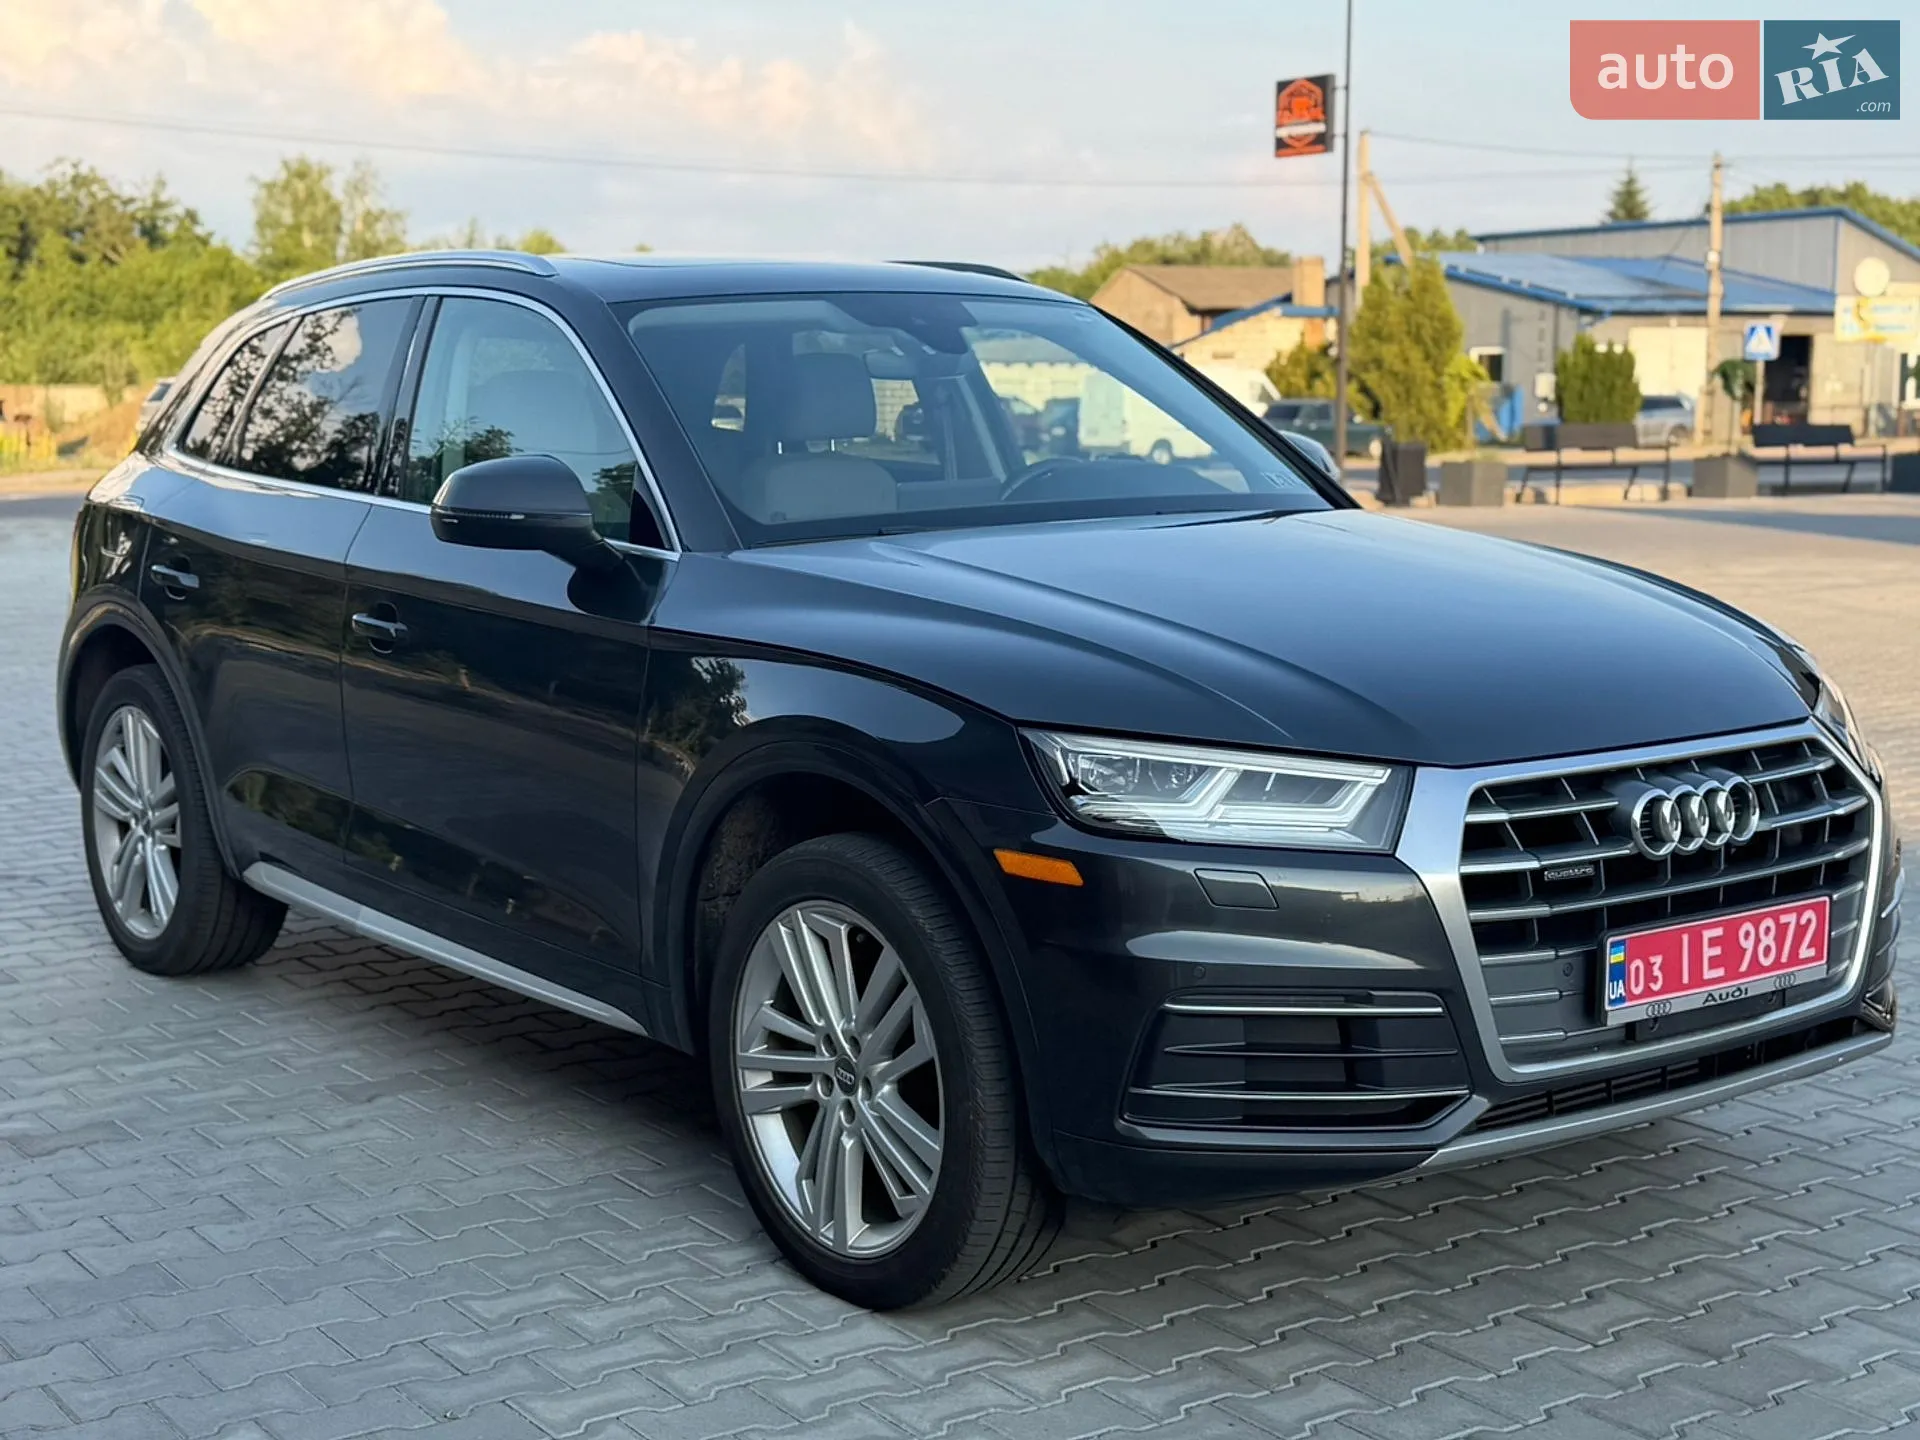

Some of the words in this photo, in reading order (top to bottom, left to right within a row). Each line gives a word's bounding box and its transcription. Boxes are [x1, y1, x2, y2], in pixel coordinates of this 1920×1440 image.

[1629, 954, 1664, 995] 03
[1682, 926, 1726, 985] IE
[1738, 908, 1818, 973] 9872
[1609, 979, 1626, 999] UA
[1702, 986, 1749, 1005] Audi
